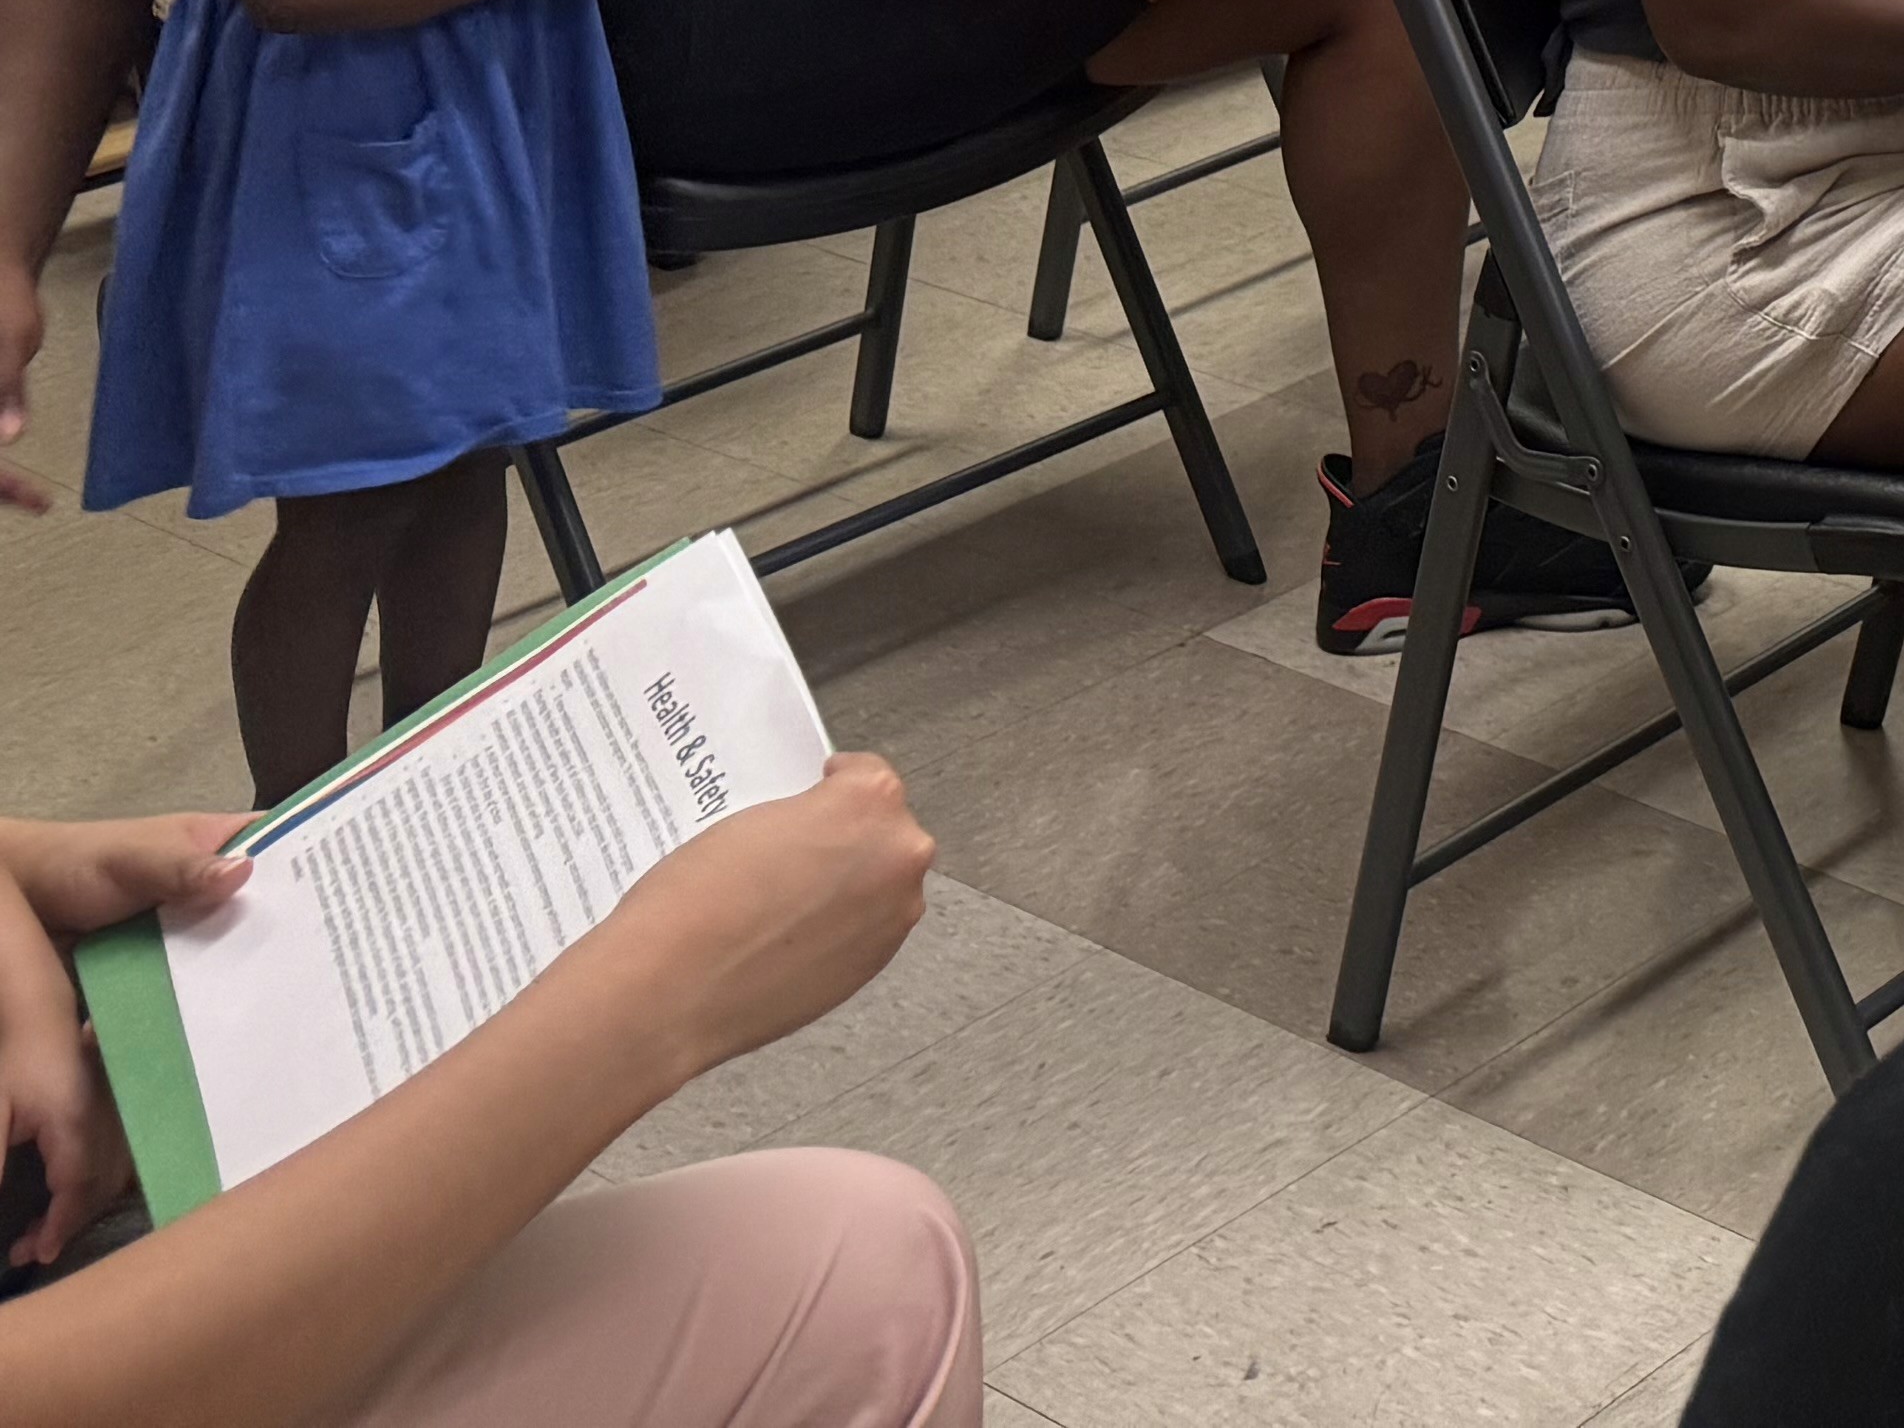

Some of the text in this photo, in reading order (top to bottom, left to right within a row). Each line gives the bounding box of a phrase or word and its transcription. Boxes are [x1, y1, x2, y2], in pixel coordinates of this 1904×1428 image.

[642, 670, 729, 824] Health & Safety
